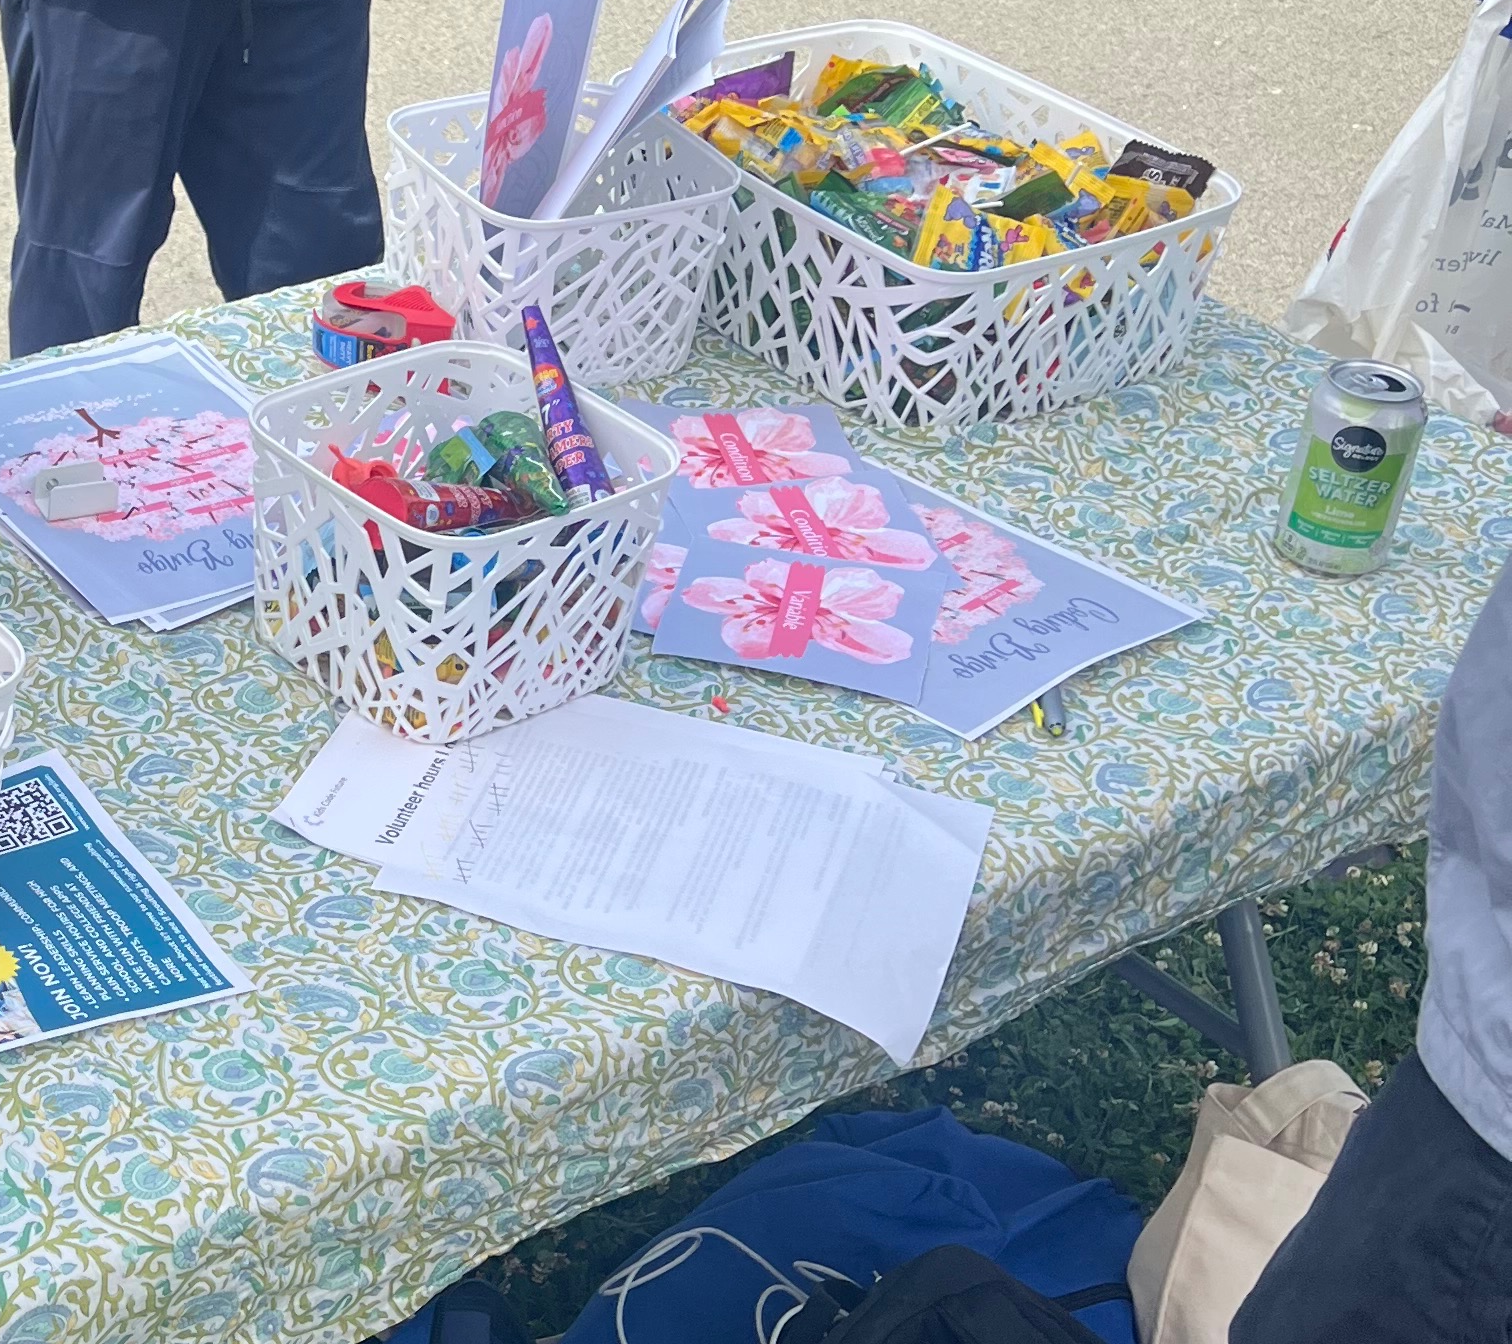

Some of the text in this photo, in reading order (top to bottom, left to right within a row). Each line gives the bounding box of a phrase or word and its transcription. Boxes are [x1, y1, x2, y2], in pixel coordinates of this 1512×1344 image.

[720, 432, 755, 483] Condition
[1308, 465, 1392, 496] SELTZER
[1316, 482, 1379, 508] WATER
[136, 538, 235, 574] Bingo
[790, 509, 828, 557] Conditio
[782, 590, 813, 631] Variable
[948, 597, 1120, 679] Coding Bingo
[375, 757, 446, 845] Volunteer hours
[26, 880, 126, 996] GAIN SERVICE HOURS FOR HIGH
[50, 885, 141, 992] SCHOOL AND COLLEGE APPS
[60, 857, 170, 985] CAMPOUTS, TROOP MEETINGS, AND
[64, 882, 156, 989] HAVE FUN WITH FRIENDS AT
[145, 911, 163, 931] Come
[32, 924, 74, 976] LEADERSHIP,
[52, 929, 110, 1000] PLANNING SKILLS
[161, 957, 186, 981] MORE
[168, 941, 187, 961] about
[18, 943, 87, 1019] JOIN NOW!
[69, 977, 96, 1004] LEARN
